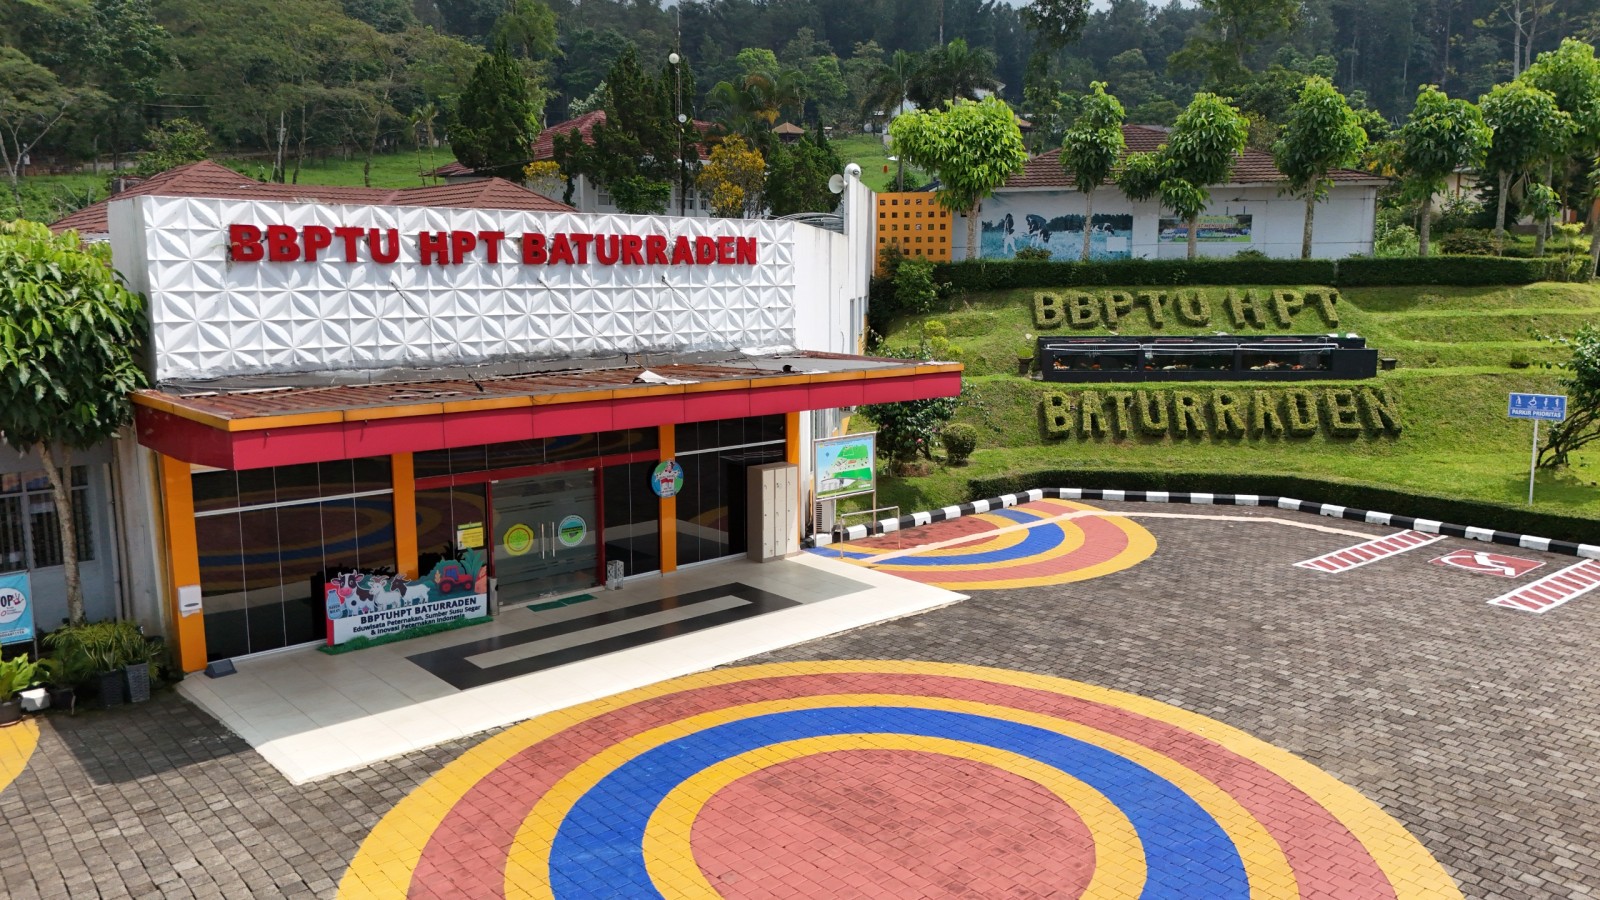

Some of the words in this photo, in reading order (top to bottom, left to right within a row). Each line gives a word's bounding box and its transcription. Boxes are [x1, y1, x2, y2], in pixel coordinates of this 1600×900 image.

[229, 223, 400, 264] BBPTU
[419, 230, 505, 265] HPT
[522, 232, 757, 266] BATURRADEN
[1034, 288, 1211, 329] BBPTU
[1227, 286, 1340, 330] HPT
[1043, 387, 1404, 440] BATURRADEN
[353, 622, 386, 633] Eduwisata
[424, 611, 448, 621] Sumber
[449, 608, 463, 617] Susu
[464, 605, 482, 616] Segar
[360, 608, 412, 624] BBPTUHPT
[414, 597, 477, 615] BATURRADEN
[377, 626, 400, 635] Inovasi
[401, 619, 436, 629] Peternakan
[436, 613, 466, 623] Indonesia
